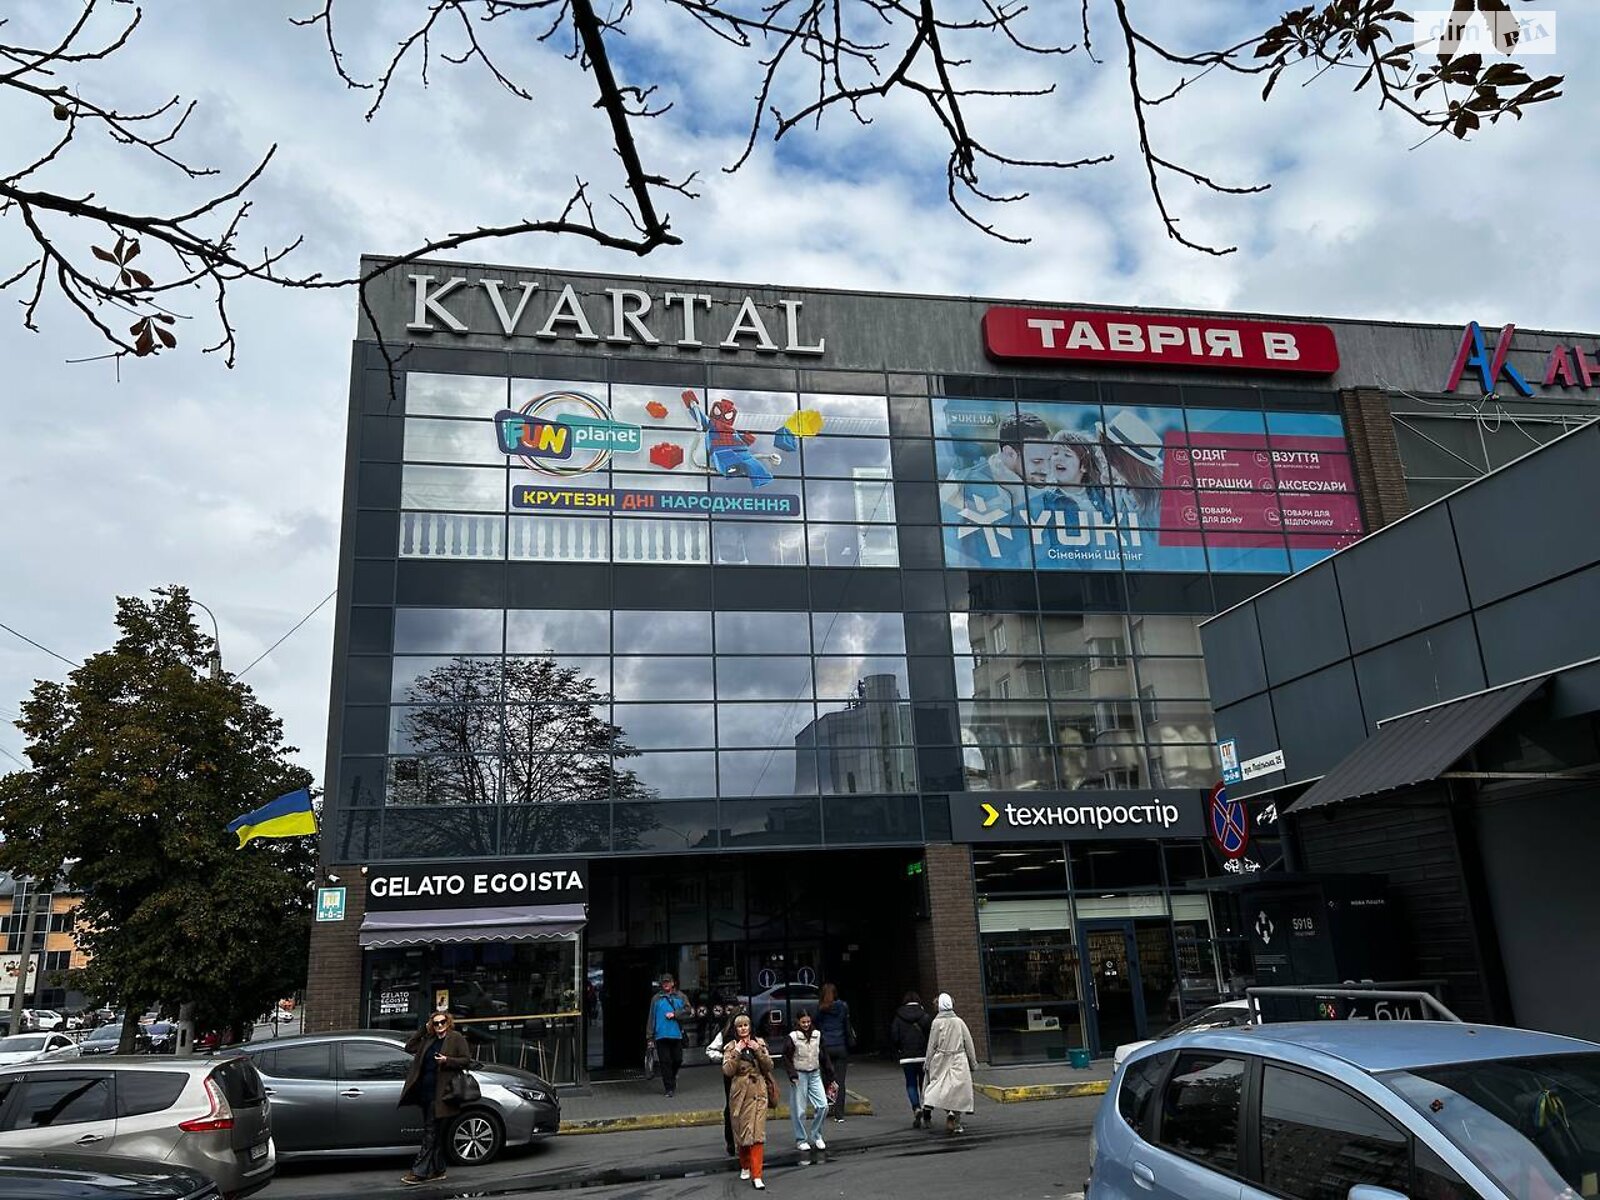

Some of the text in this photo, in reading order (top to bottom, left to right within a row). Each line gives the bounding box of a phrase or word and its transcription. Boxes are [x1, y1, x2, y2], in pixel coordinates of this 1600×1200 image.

[406, 274, 825, 355] KVARTAL
[1027, 318, 1301, 361] ТАВРІЯ В
[502, 416, 638, 455] FUN planet
[1191, 449, 1228, 462] ОДЯГ
[1272, 451, 1320, 463] ВЗУТТЯ
[1196, 477, 1253, 489] ІГРАШКИ
[1278, 479, 1348, 492] АКСЕСУАРИ
[523, 490, 791, 512] КРУТЕЗНІ ДНІ НАРОДЖЕННЯ
[1200, 507, 1232, 516] ТОВАРИ
[1282, 509, 1330, 519] ТОВАРИ ДЛЯ
[1202, 516, 1243, 526] ДЛЯ ДОМУ
[1019, 509, 1142, 547] YUKI
[1048, 549, 1143, 561] Сімейний Шопінг
[370, 870, 584, 897] GELATO EGOISTA
[1292, 917, 1314, 931] 5918
